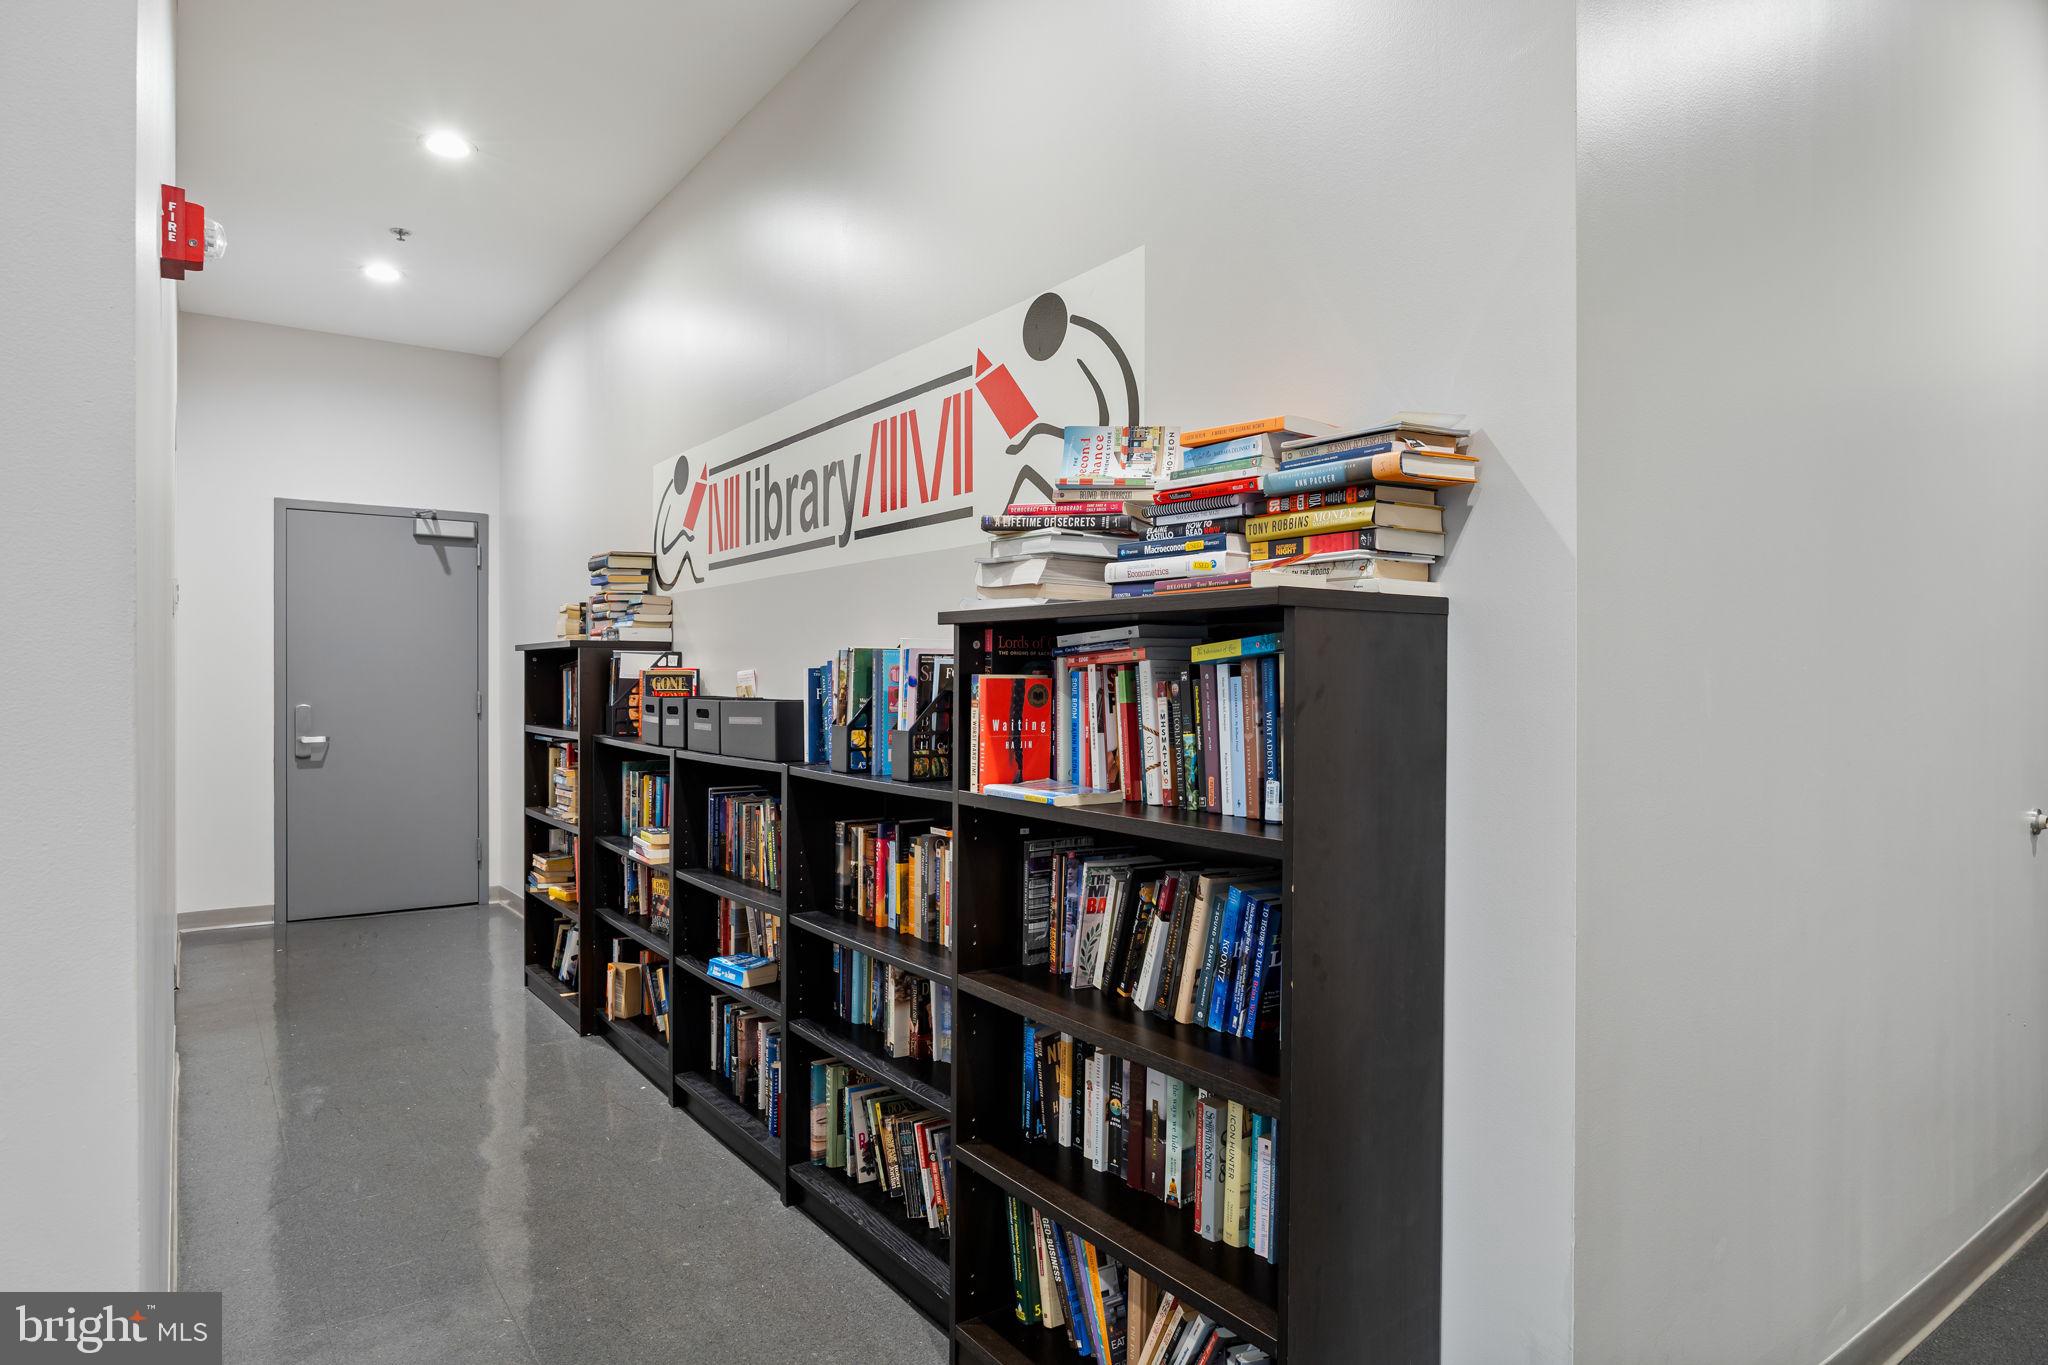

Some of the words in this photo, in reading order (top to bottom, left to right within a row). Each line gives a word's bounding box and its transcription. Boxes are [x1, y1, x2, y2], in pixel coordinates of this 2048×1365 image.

[168, 201, 177, 242] FIRE
[1093, 434, 1105, 475] hance
[1295, 479, 1307, 488] ANN
[1309, 474, 1335, 486] PACKER
[745, 454, 862, 547] library
[1269, 499, 1280, 512] SO
[1309, 493, 1321, 508] YOU
[995, 517, 1000, 528] A
[1003, 516, 1041, 528] LIFETIME
[1044, 516, 1055, 527] OF
[1057, 515, 1096, 527] SECRETS
[1146, 526, 1169, 534] ELAINE
[1185, 521, 1202, 529] HOW
[1203, 520, 1213, 528] TO
[1185, 527, 1203, 537] READ
[1204, 525, 1220, 534] NOW
[1248, 522, 1270, 536] TONY
[1271, 516, 1309, 532] ROBBINS
[1312, 509, 1354, 523] MONEY
[1146, 531, 1174, 541] CASTILLO
[1144, 542, 1186, 555] Macroeconom
[1275, 547, 1297, 556] NIGHT
[1127, 567, 1169, 579] Econometrics
[1193, 562, 1210, 570] USED
[1310, 567, 1330, 576] WOODS
[1166, 582, 1192, 591] BELOVED
[998, 636, 1030, 650] Lords
[992, 718, 1047, 734] Waiting
[1005, 741, 1017, 750] HA
[1019, 740, 1033, 749] JIN
[1160, 713, 1169, 775] MISMATCH
[1175, 747, 1183, 783] POWELL
[1266, 738, 1274, 775] ADDICTS
[1248, 903, 1256, 925] Chicken
[1262, 908, 1269, 918] 10
[1211, 911, 1221, 937] SOUND
[1258, 919, 1268, 947] HOURS
[1205, 944, 1215, 971] GRAVEL
[1217, 939, 1230, 984] KOONTZ
[1256, 948, 1264, 959] TO
[1254, 960, 1262, 978] LIVE
[1250, 980, 1259, 1001] Brian
[1171, 1084, 1179, 1097] the
[1170, 1098, 1178, 1118] ways
[1171, 1121, 1177, 1132] we
[1204, 1110, 1215, 1146] SYMPATHY
[1229, 1114, 1237, 1141] ICON
[1171, 1134, 1179, 1153] hide
[1204, 1151, 1215, 1181] SCIENCE
[1227, 1141, 1237, 1180] HUNTER
[888, 1165, 897, 1189] Jordan
[893, 1164, 902, 1188] Robert
[933, 1173, 941, 1190] HIGGINS
[1262, 1157, 1271, 1189] DANIELLE
[1262, 1192, 1270, 1211] STEEL
[1041, 1217, 1062, 1283] GEO-BUSINESS
[1034, 1304, 1042, 1317] 5
[1111, 1336, 1126, 1350] EAT
